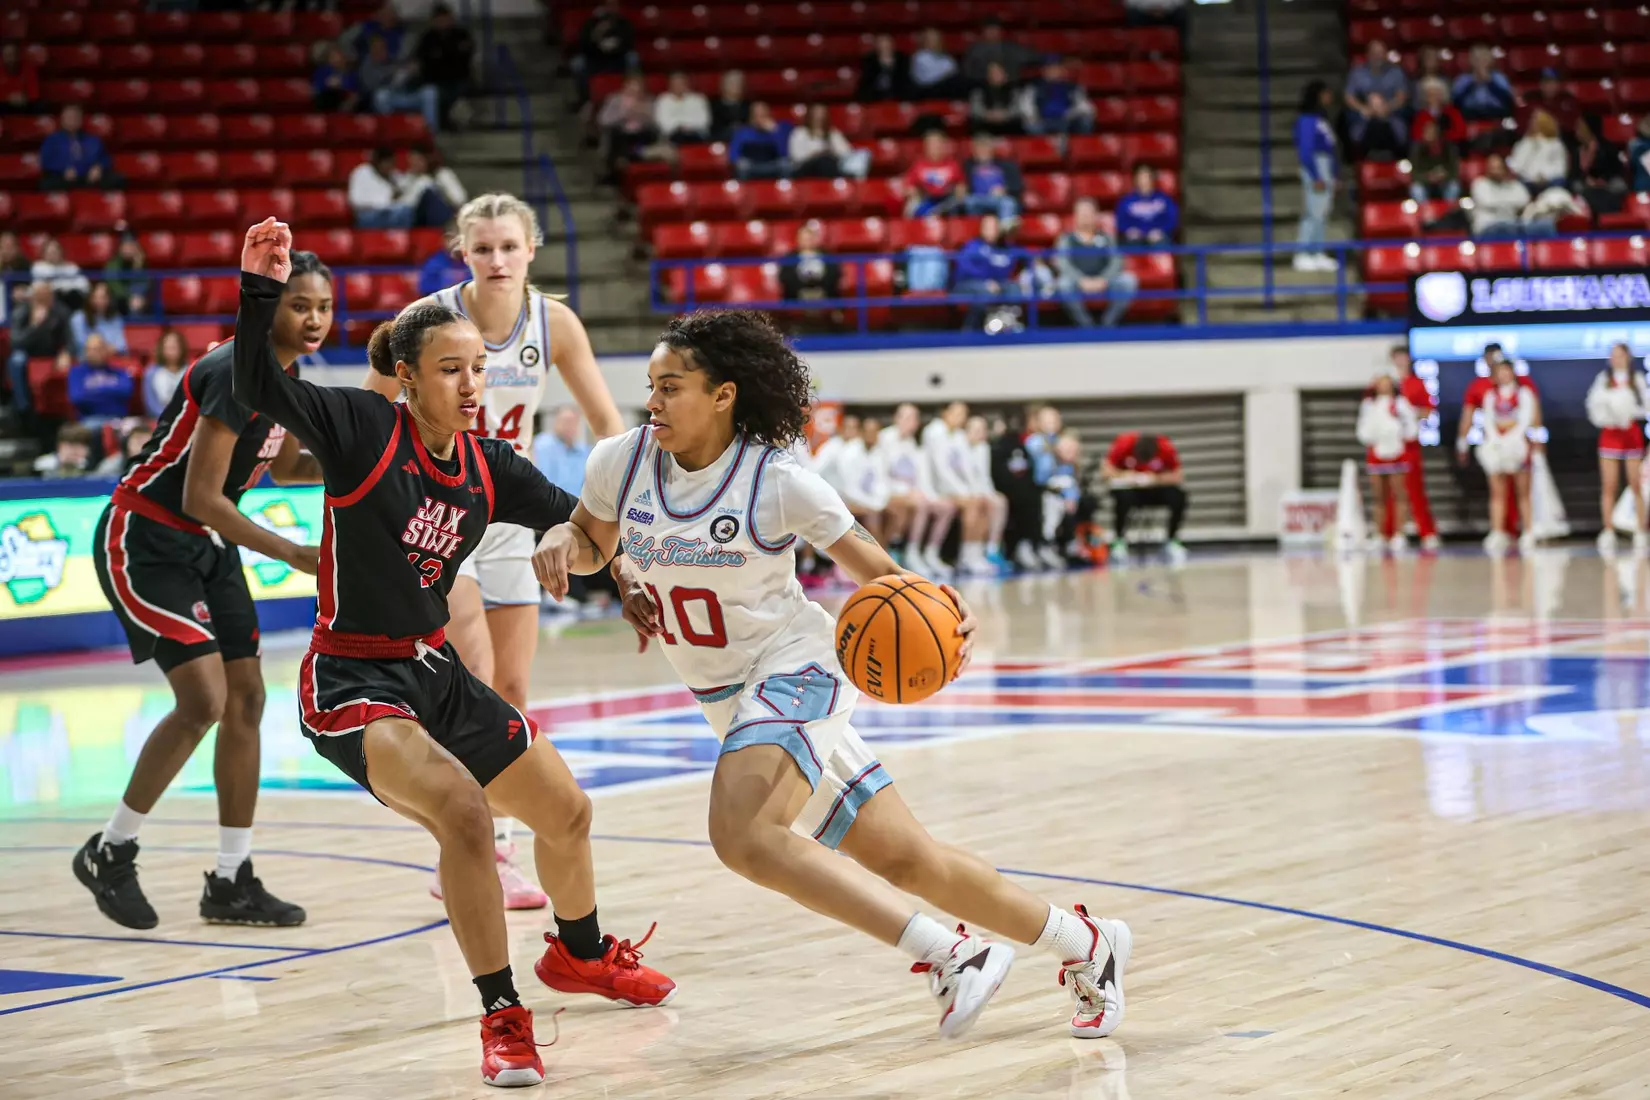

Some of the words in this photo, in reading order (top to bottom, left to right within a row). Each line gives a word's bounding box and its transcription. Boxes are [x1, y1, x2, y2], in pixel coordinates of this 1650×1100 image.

[467, 404, 526, 449] 14
[417, 496, 468, 535] JAX
[401, 517, 464, 559] STATE
[622, 527, 656, 572] Lady
[655, 536, 746, 567] Techsters
[644, 582, 729, 648] 10
[866, 655, 884, 698] EVO
